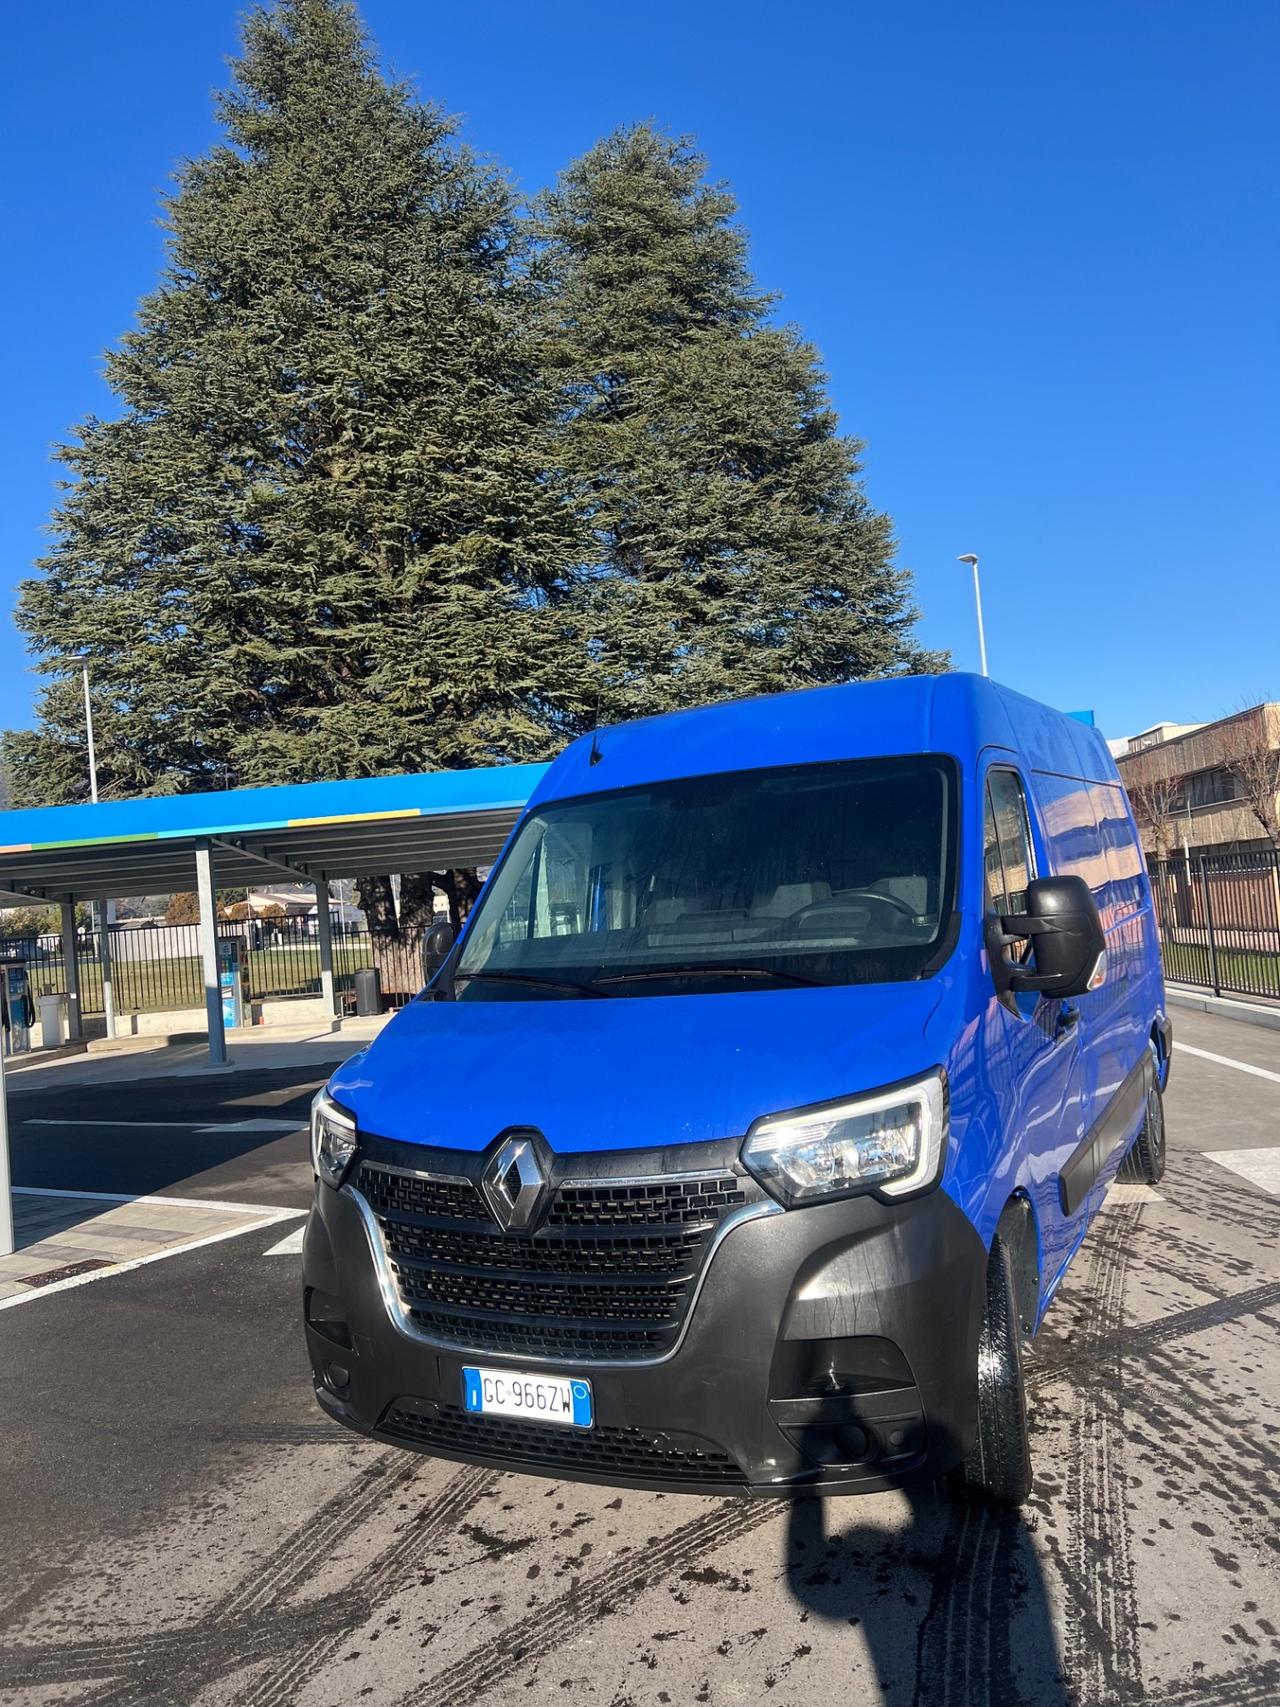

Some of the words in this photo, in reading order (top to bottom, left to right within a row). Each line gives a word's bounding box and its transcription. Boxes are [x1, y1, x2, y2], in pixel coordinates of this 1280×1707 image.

[472, 1390, 477, 1406] I
[483, 1378, 505, 1404] GC
[512, 1381, 571, 1413] 966ZW
